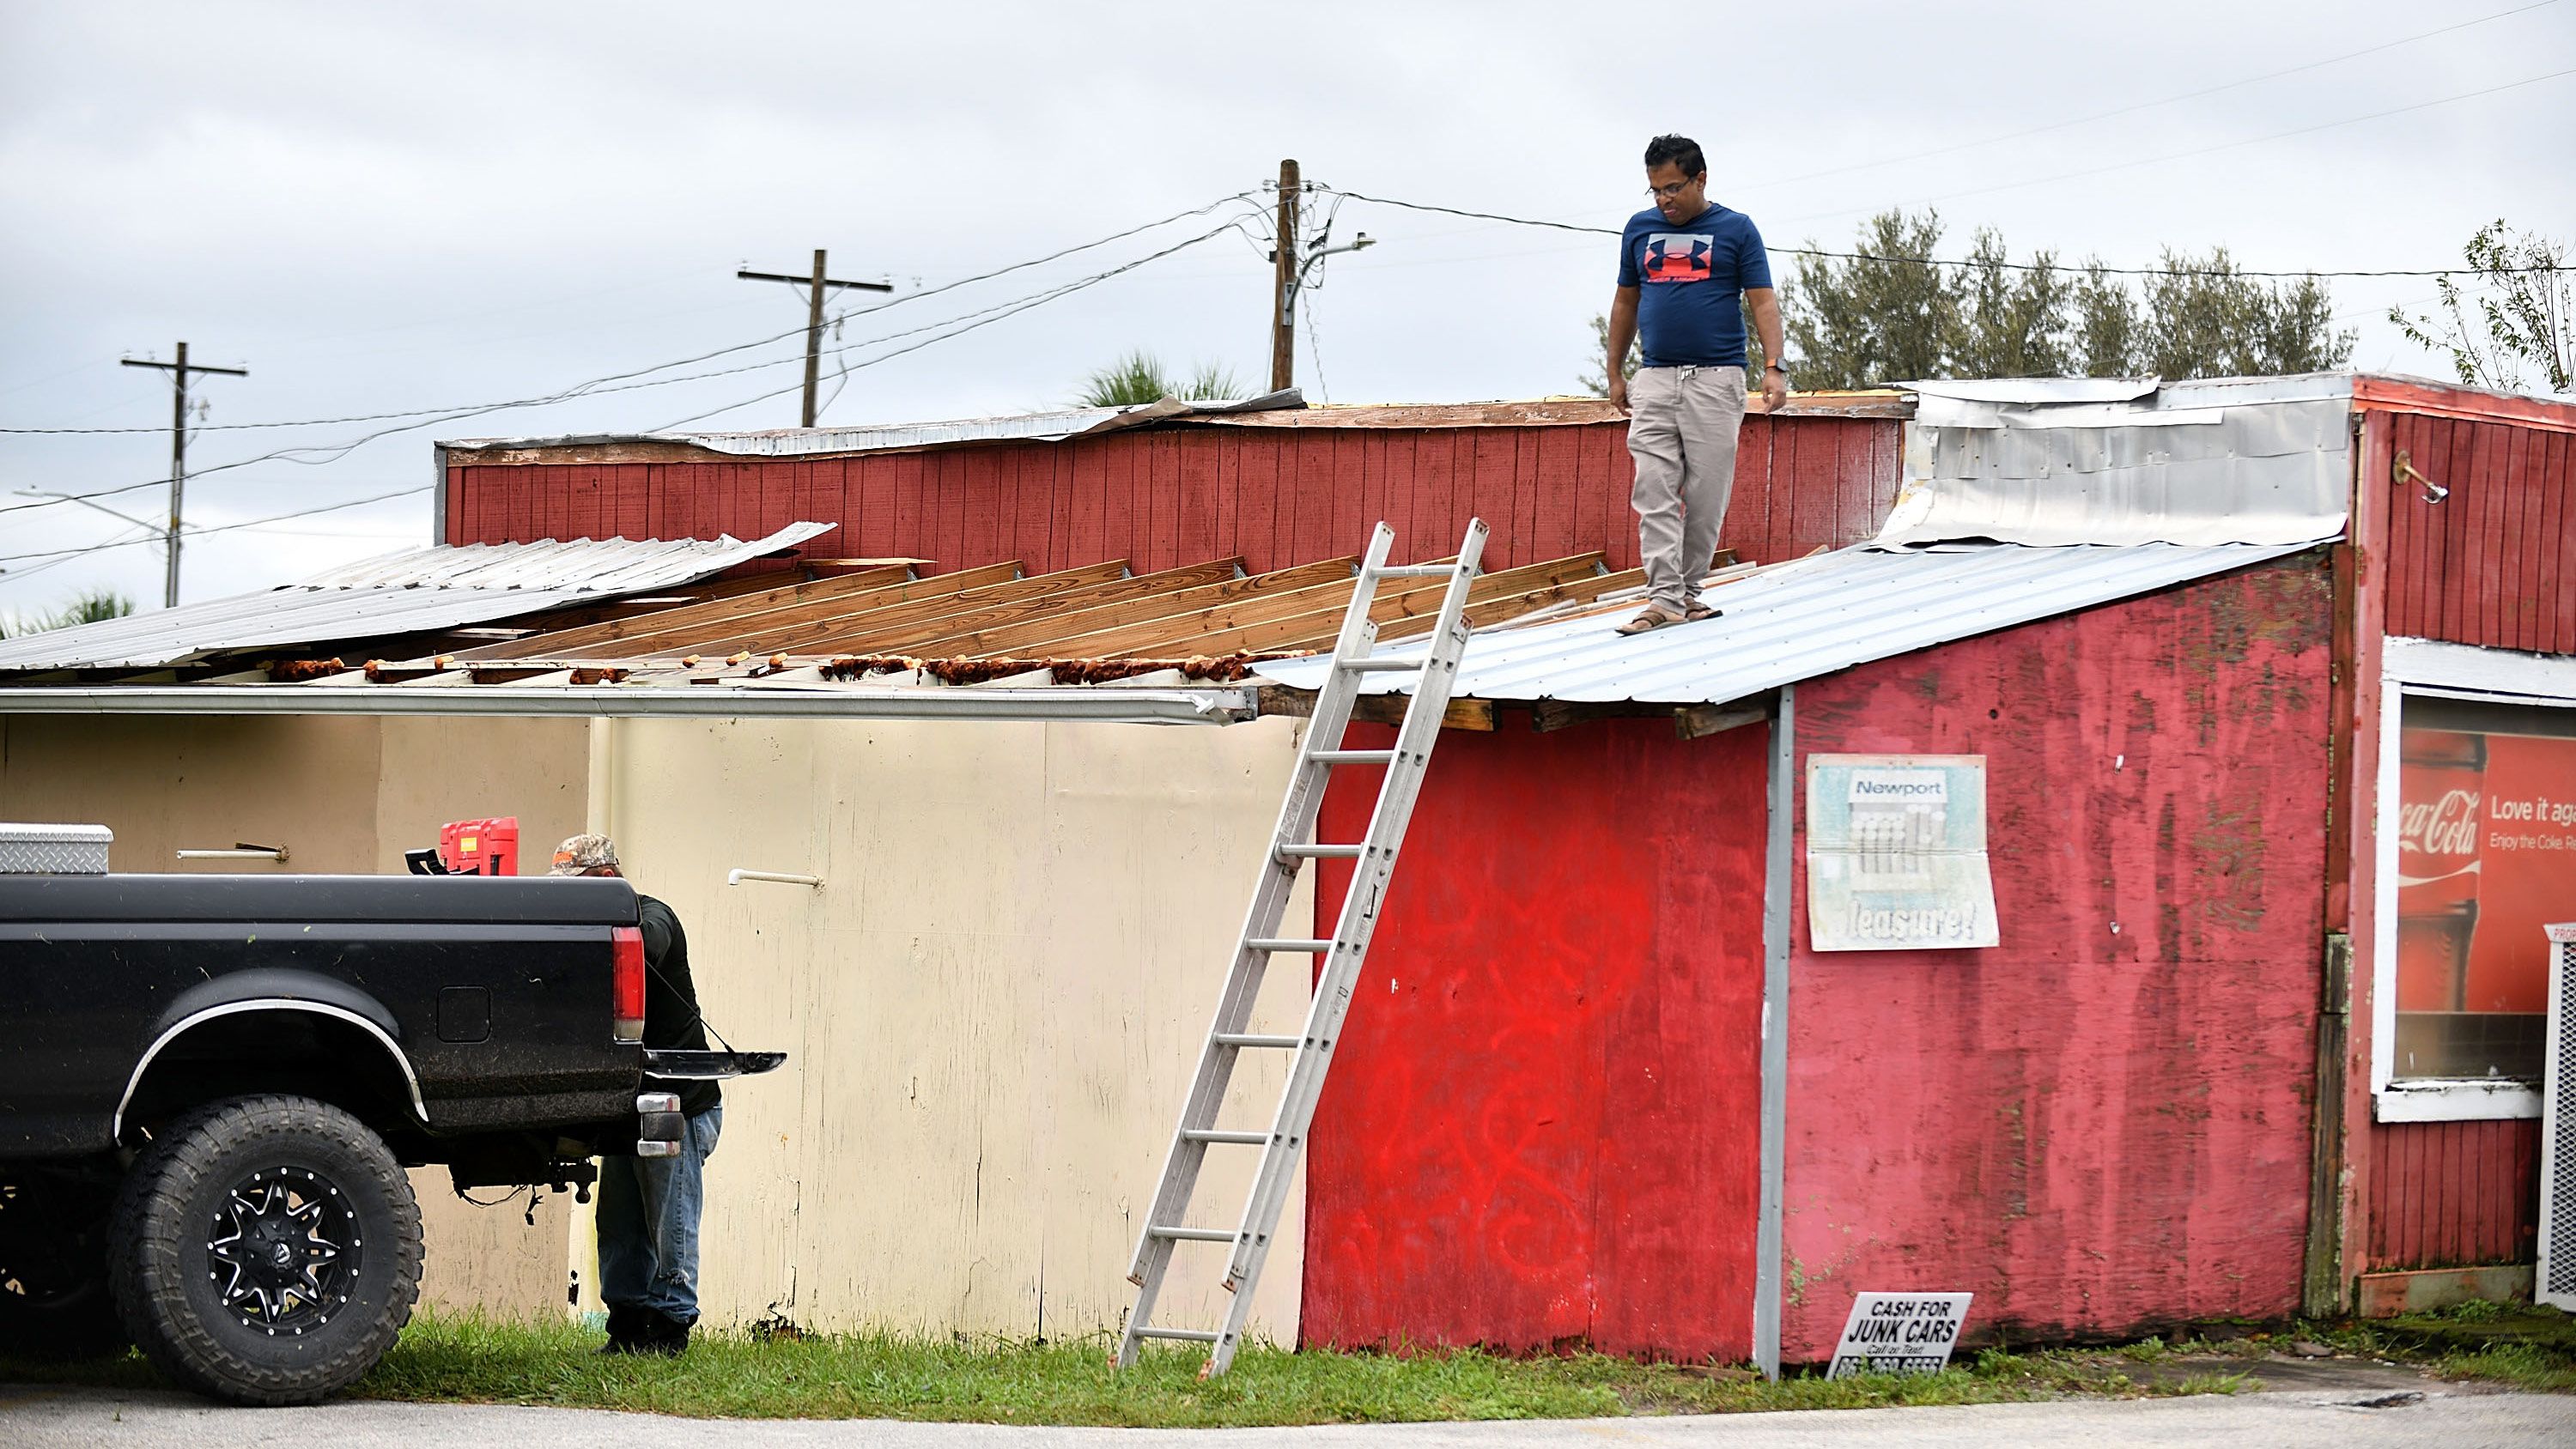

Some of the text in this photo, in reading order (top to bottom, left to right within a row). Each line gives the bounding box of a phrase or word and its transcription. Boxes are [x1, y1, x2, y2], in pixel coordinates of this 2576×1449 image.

[1856, 780, 1941, 797] Newport
[2491, 795, 2533, 821] Love
[2537, 797, 2549, 822] it
[2490, 832, 2518, 852] Enjoy
[2519, 834, 2537, 849] the
[1871, 1300, 1952, 1317] CASH FOR
[1849, 1319, 1956, 1343] JUNK CARS
[1866, 1344, 1888, 1355] Call
